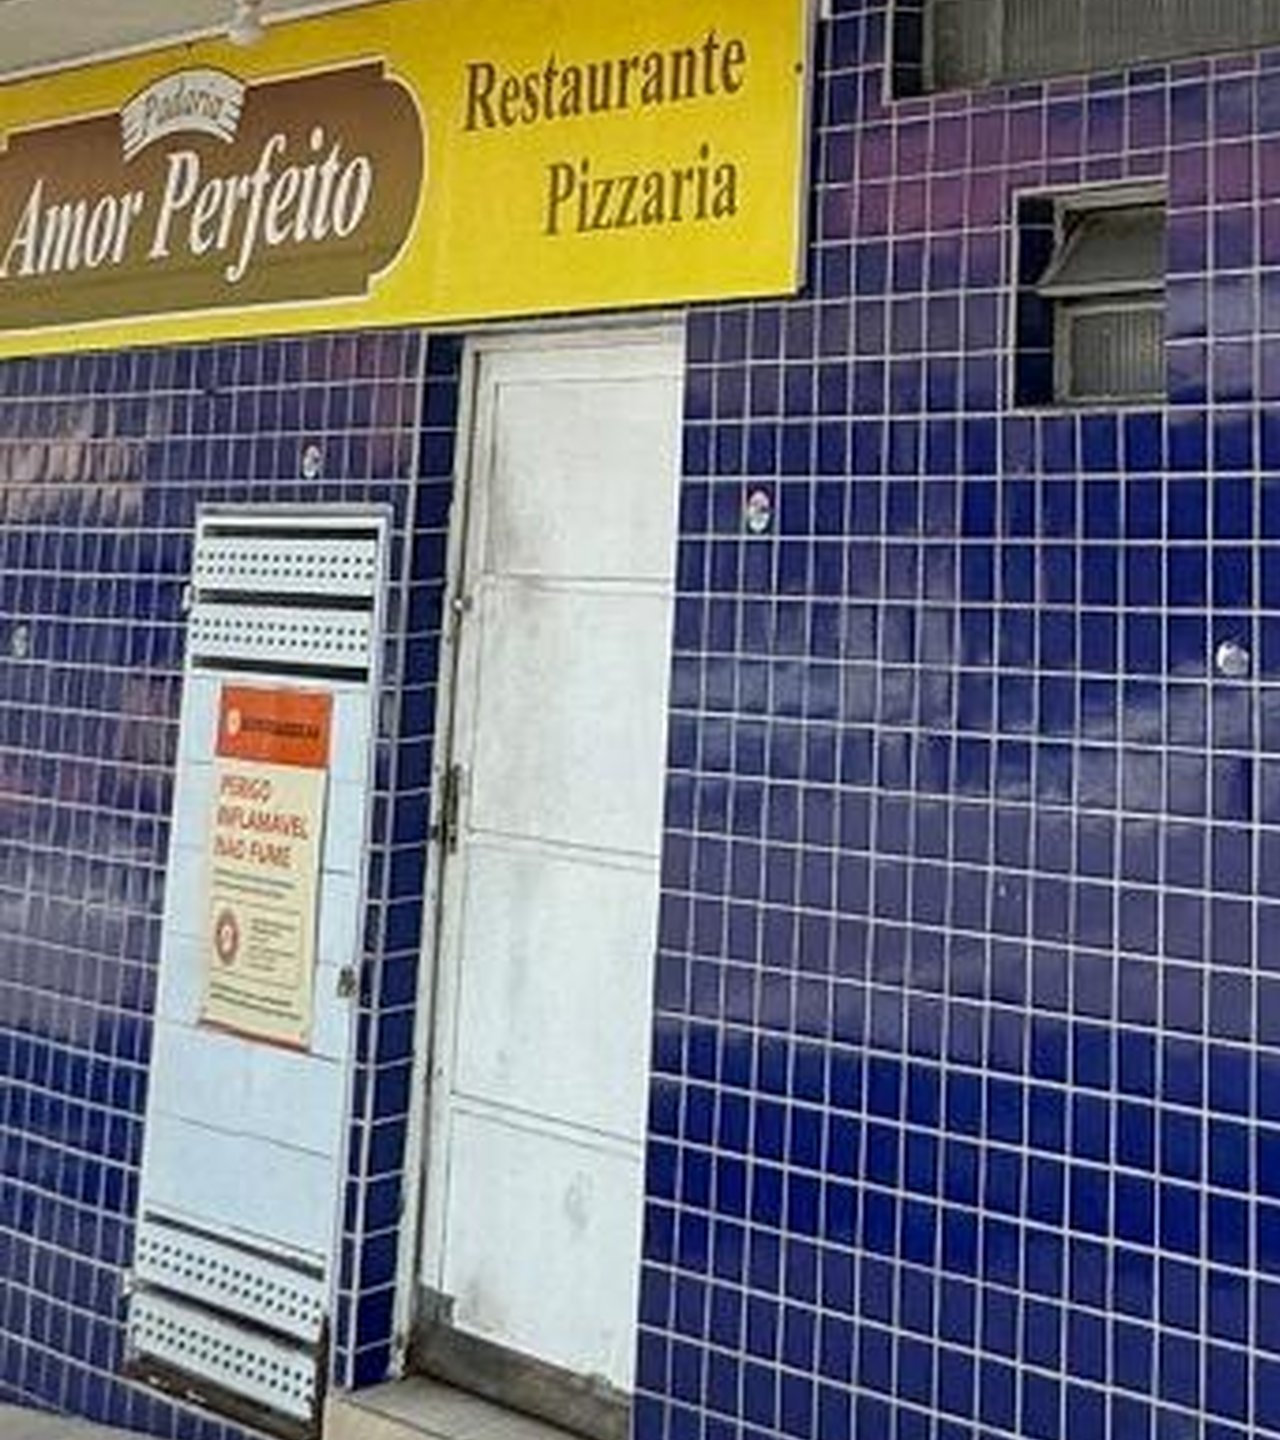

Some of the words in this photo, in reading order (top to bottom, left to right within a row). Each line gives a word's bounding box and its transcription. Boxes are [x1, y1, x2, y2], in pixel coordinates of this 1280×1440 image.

[463, 25, 746, 132] Restaurante
[0, 178, 144, 280] Amor
[148, 126, 373, 284] Perfeito
[544, 141, 738, 236] Pizzaria
